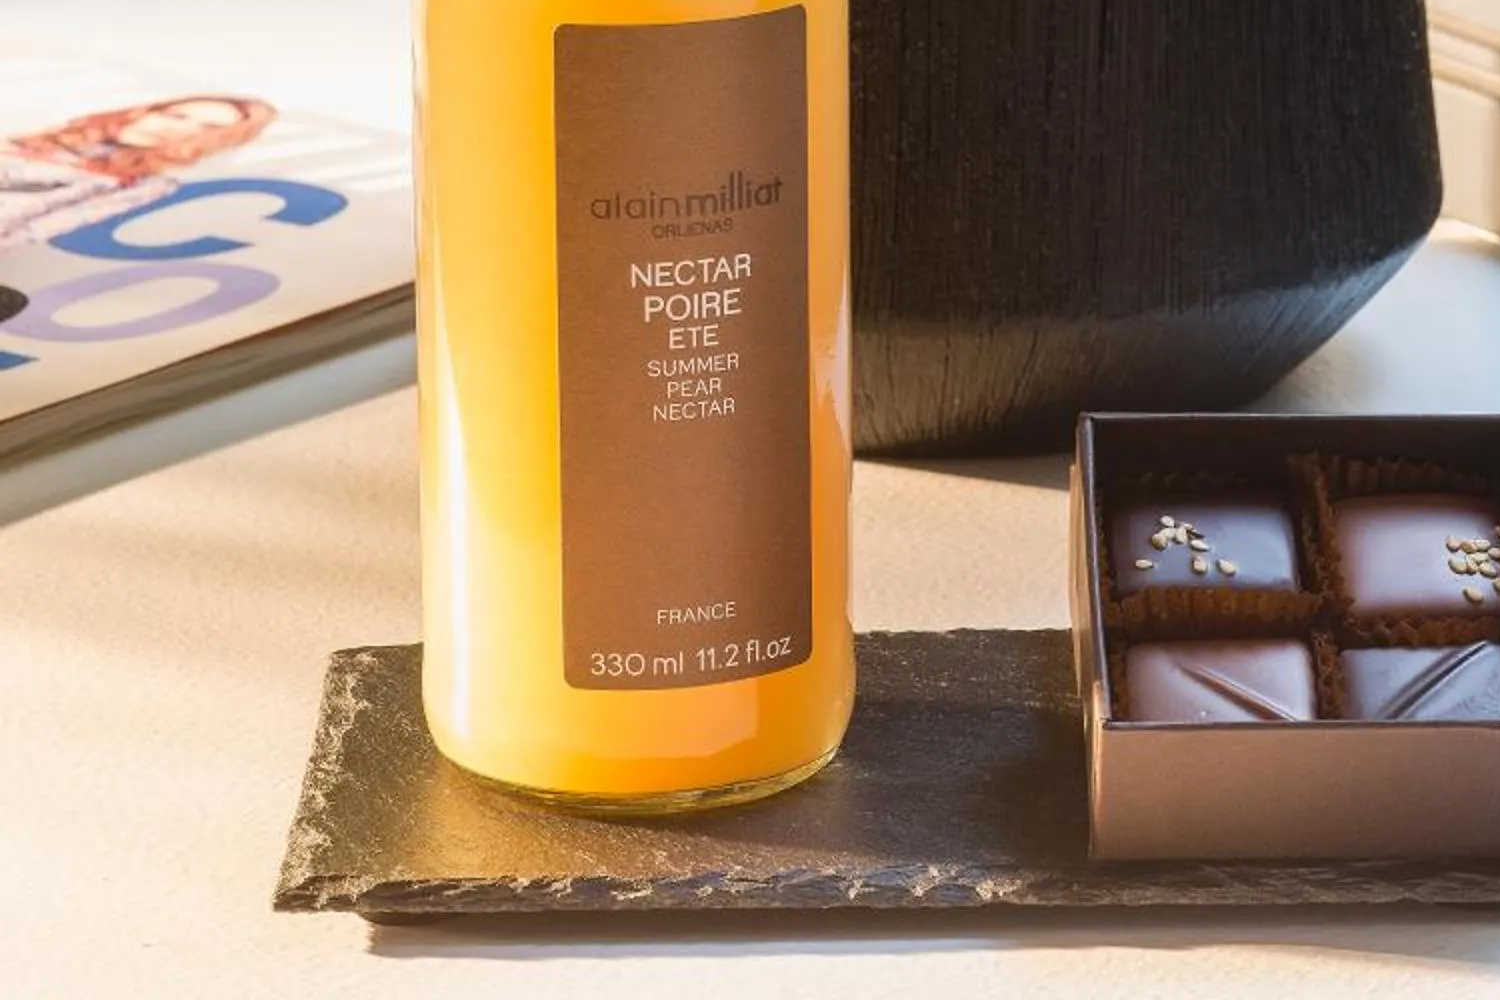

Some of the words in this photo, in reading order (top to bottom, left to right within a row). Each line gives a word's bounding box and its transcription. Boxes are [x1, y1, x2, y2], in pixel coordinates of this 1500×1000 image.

[631, 254, 751, 288] NECTAR
[643, 288, 742, 323] POIRE
[668, 325, 720, 350] ETE
[647, 353, 740, 378] SUMMER
[667, 378, 722, 400] PEAR
[653, 398, 736, 421] NECTAR
[656, 601, 737, 625] FRANCE
[590, 652, 646, 677] 330
[652, 651, 684, 676] ml
[696, 643, 740, 671] 11.2
[745, 635, 792, 664] fl.oz
